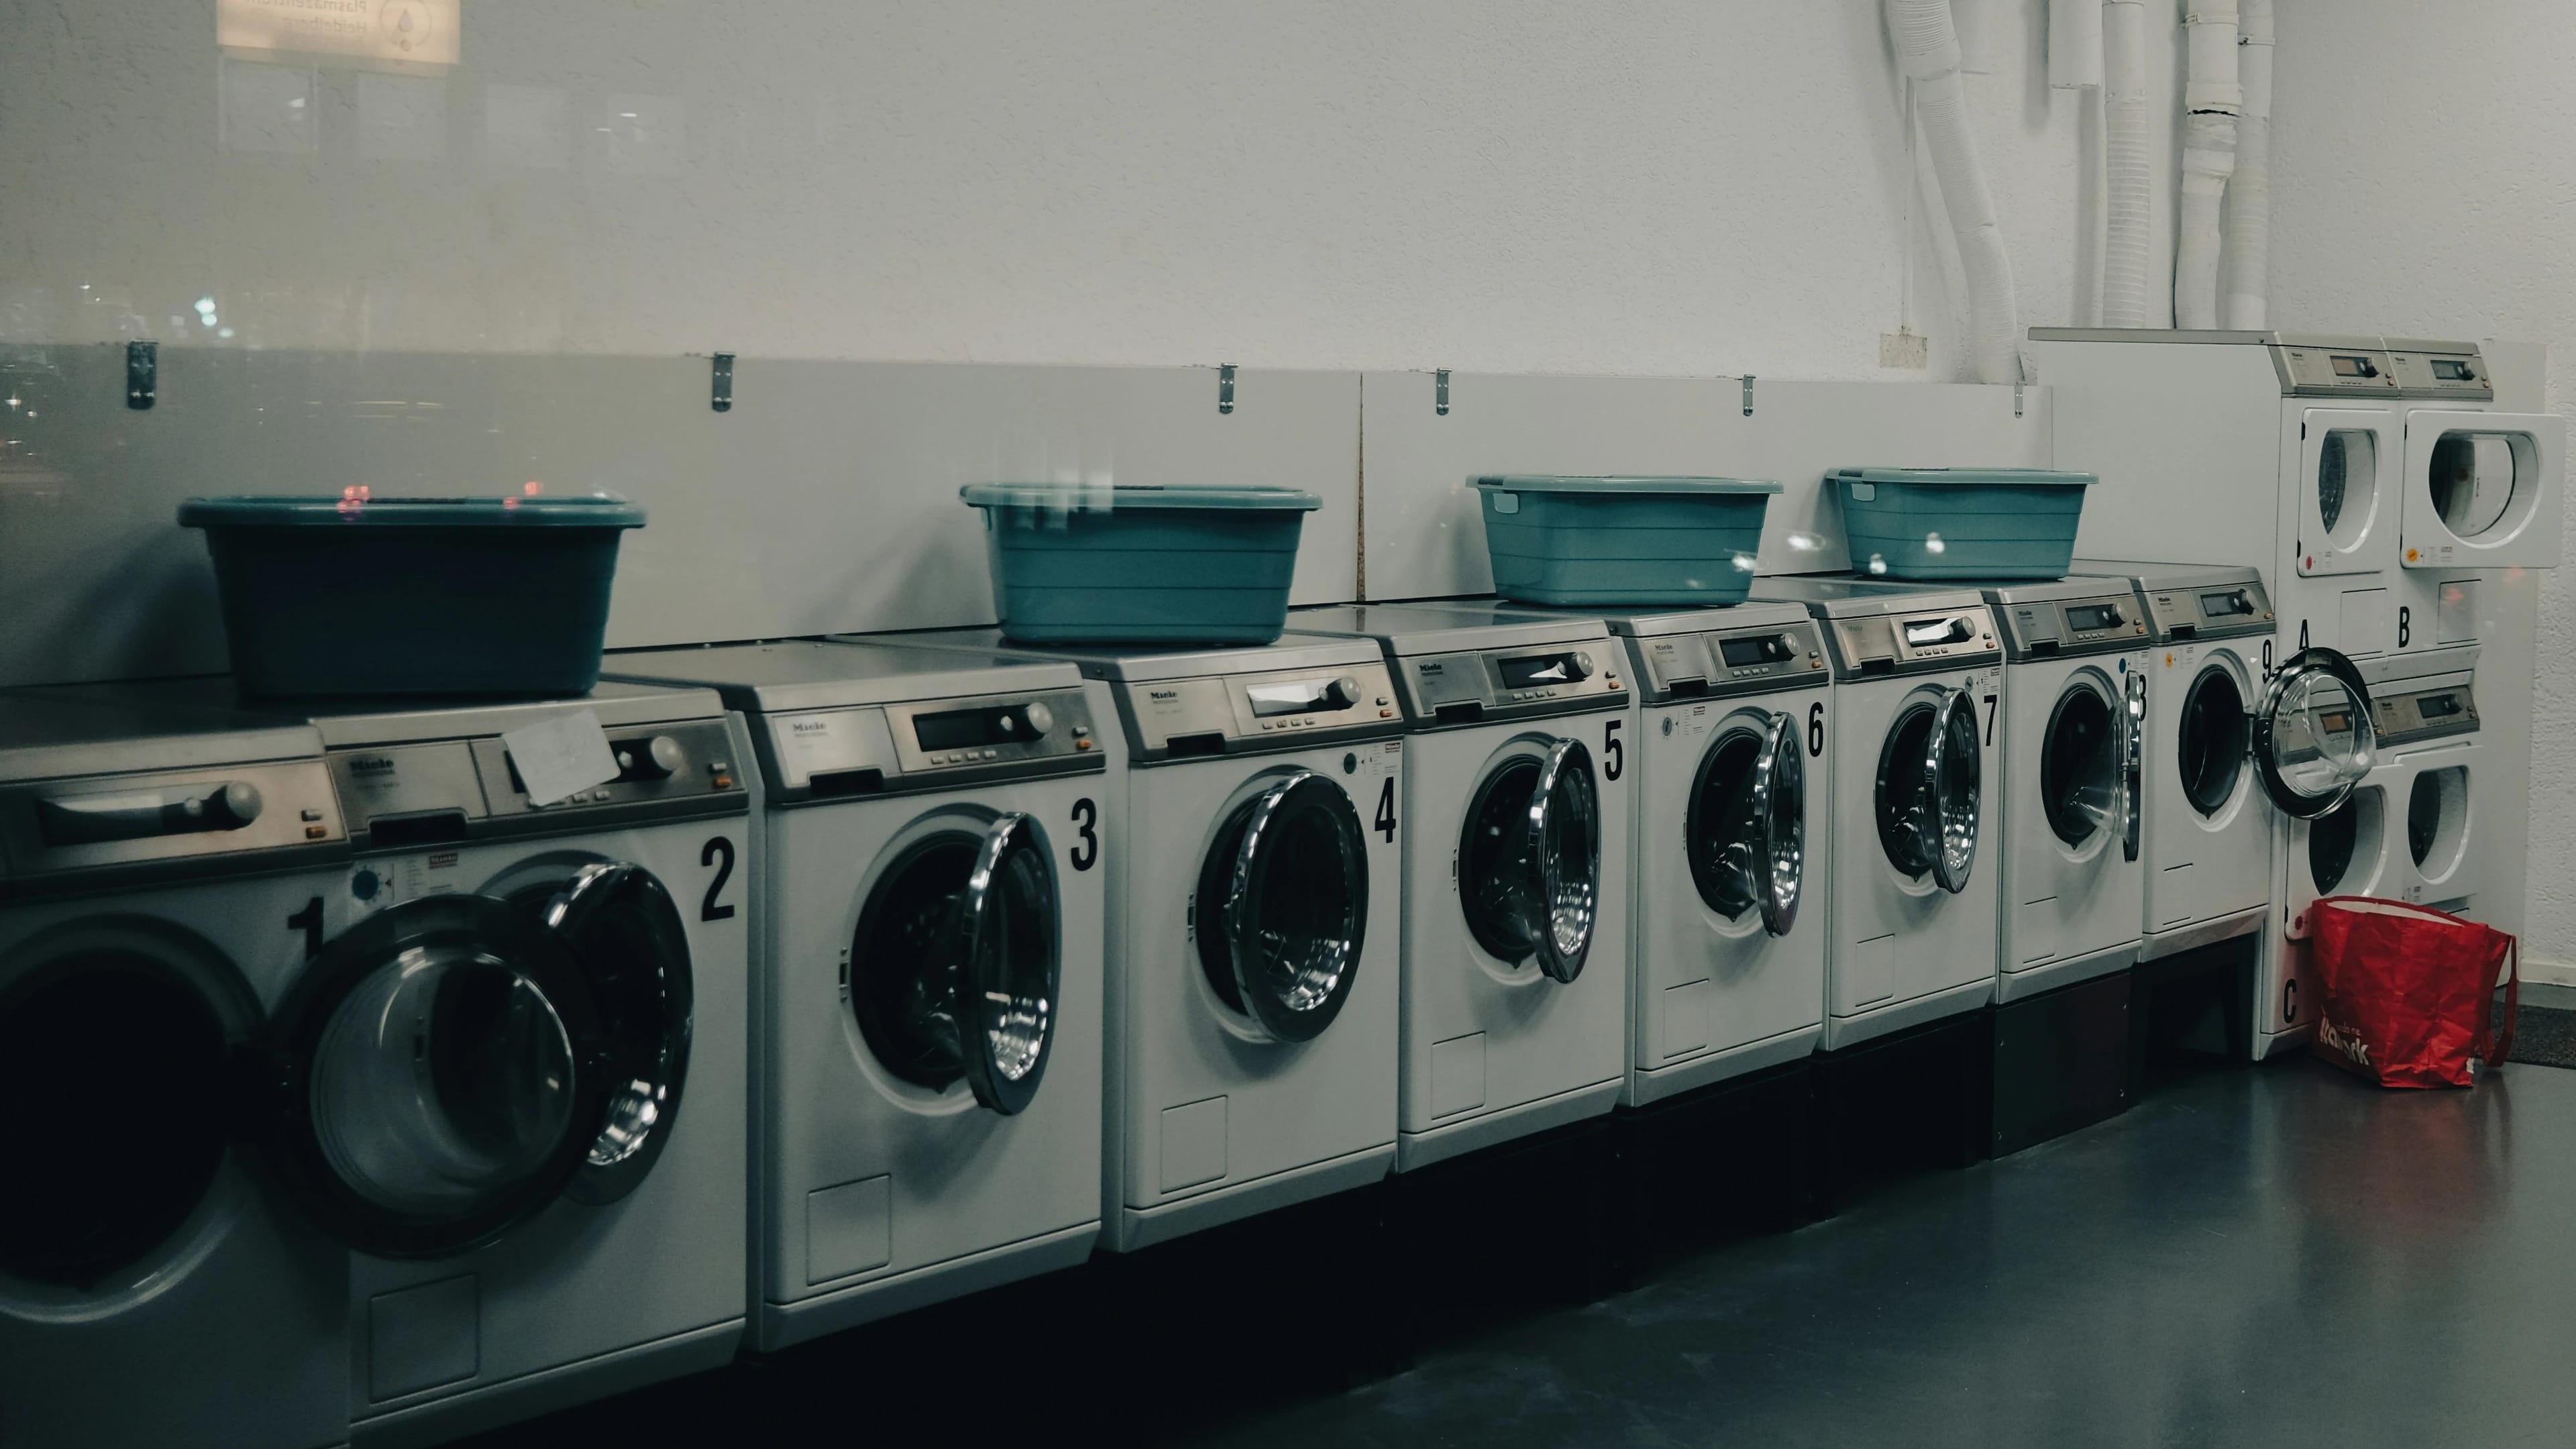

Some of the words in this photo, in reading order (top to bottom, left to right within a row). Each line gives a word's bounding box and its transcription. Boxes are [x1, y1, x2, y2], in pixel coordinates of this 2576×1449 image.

[2299, 619, 2310, 649] A
[2399, 606, 2410, 647] B
[1419, 663, 1442, 672] Miele
[2262, 639, 2272, 684] 9
[1150, 690, 1179, 700] Miele
[793, 721, 827, 732] Miele
[1809, 702, 1824, 757] 6
[1984, 695, 1998, 747] 7
[350, 758, 394, 771] Miele
[1605, 720, 1623, 781] 5
[1375, 777, 1396, 843] 4
[1071, 798, 1097, 871] 3
[701, 837, 735, 922] 2
[288, 897, 324, 960] 1
[2284, 979, 2298, 1024] C
